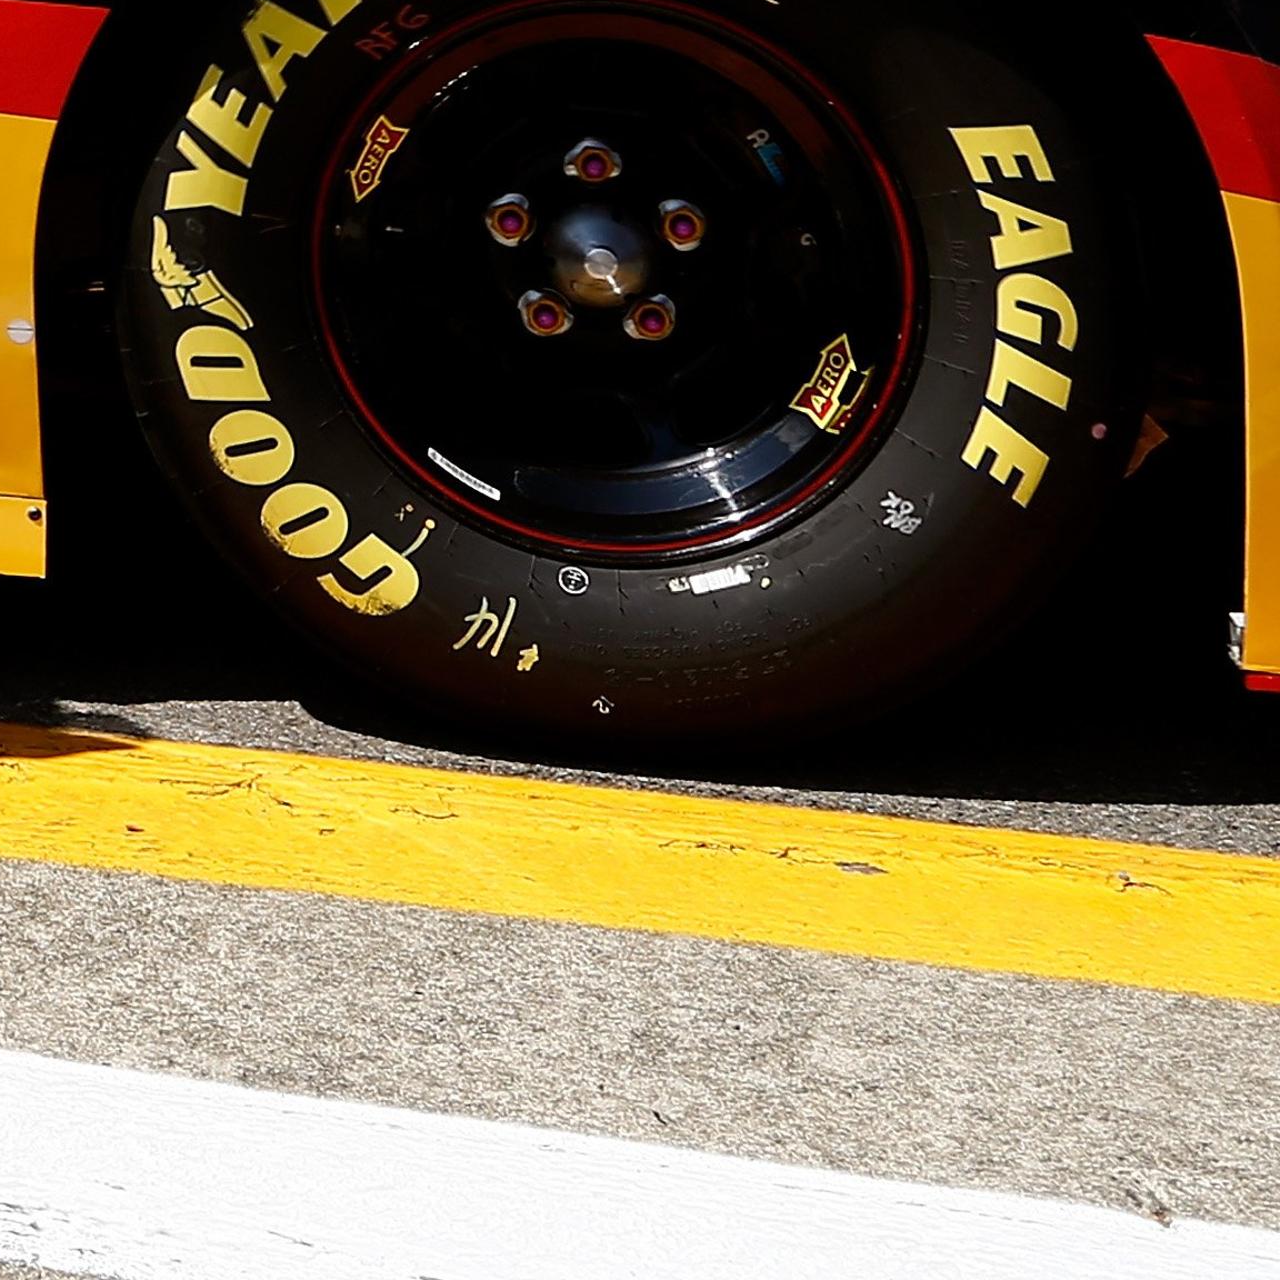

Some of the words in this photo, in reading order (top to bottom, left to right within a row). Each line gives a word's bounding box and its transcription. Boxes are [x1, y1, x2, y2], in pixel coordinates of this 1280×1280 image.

[358, 128, 392, 185] AERO
[948, 124, 1079, 507] EAGLE
[810, 352, 846, 414] AERO
